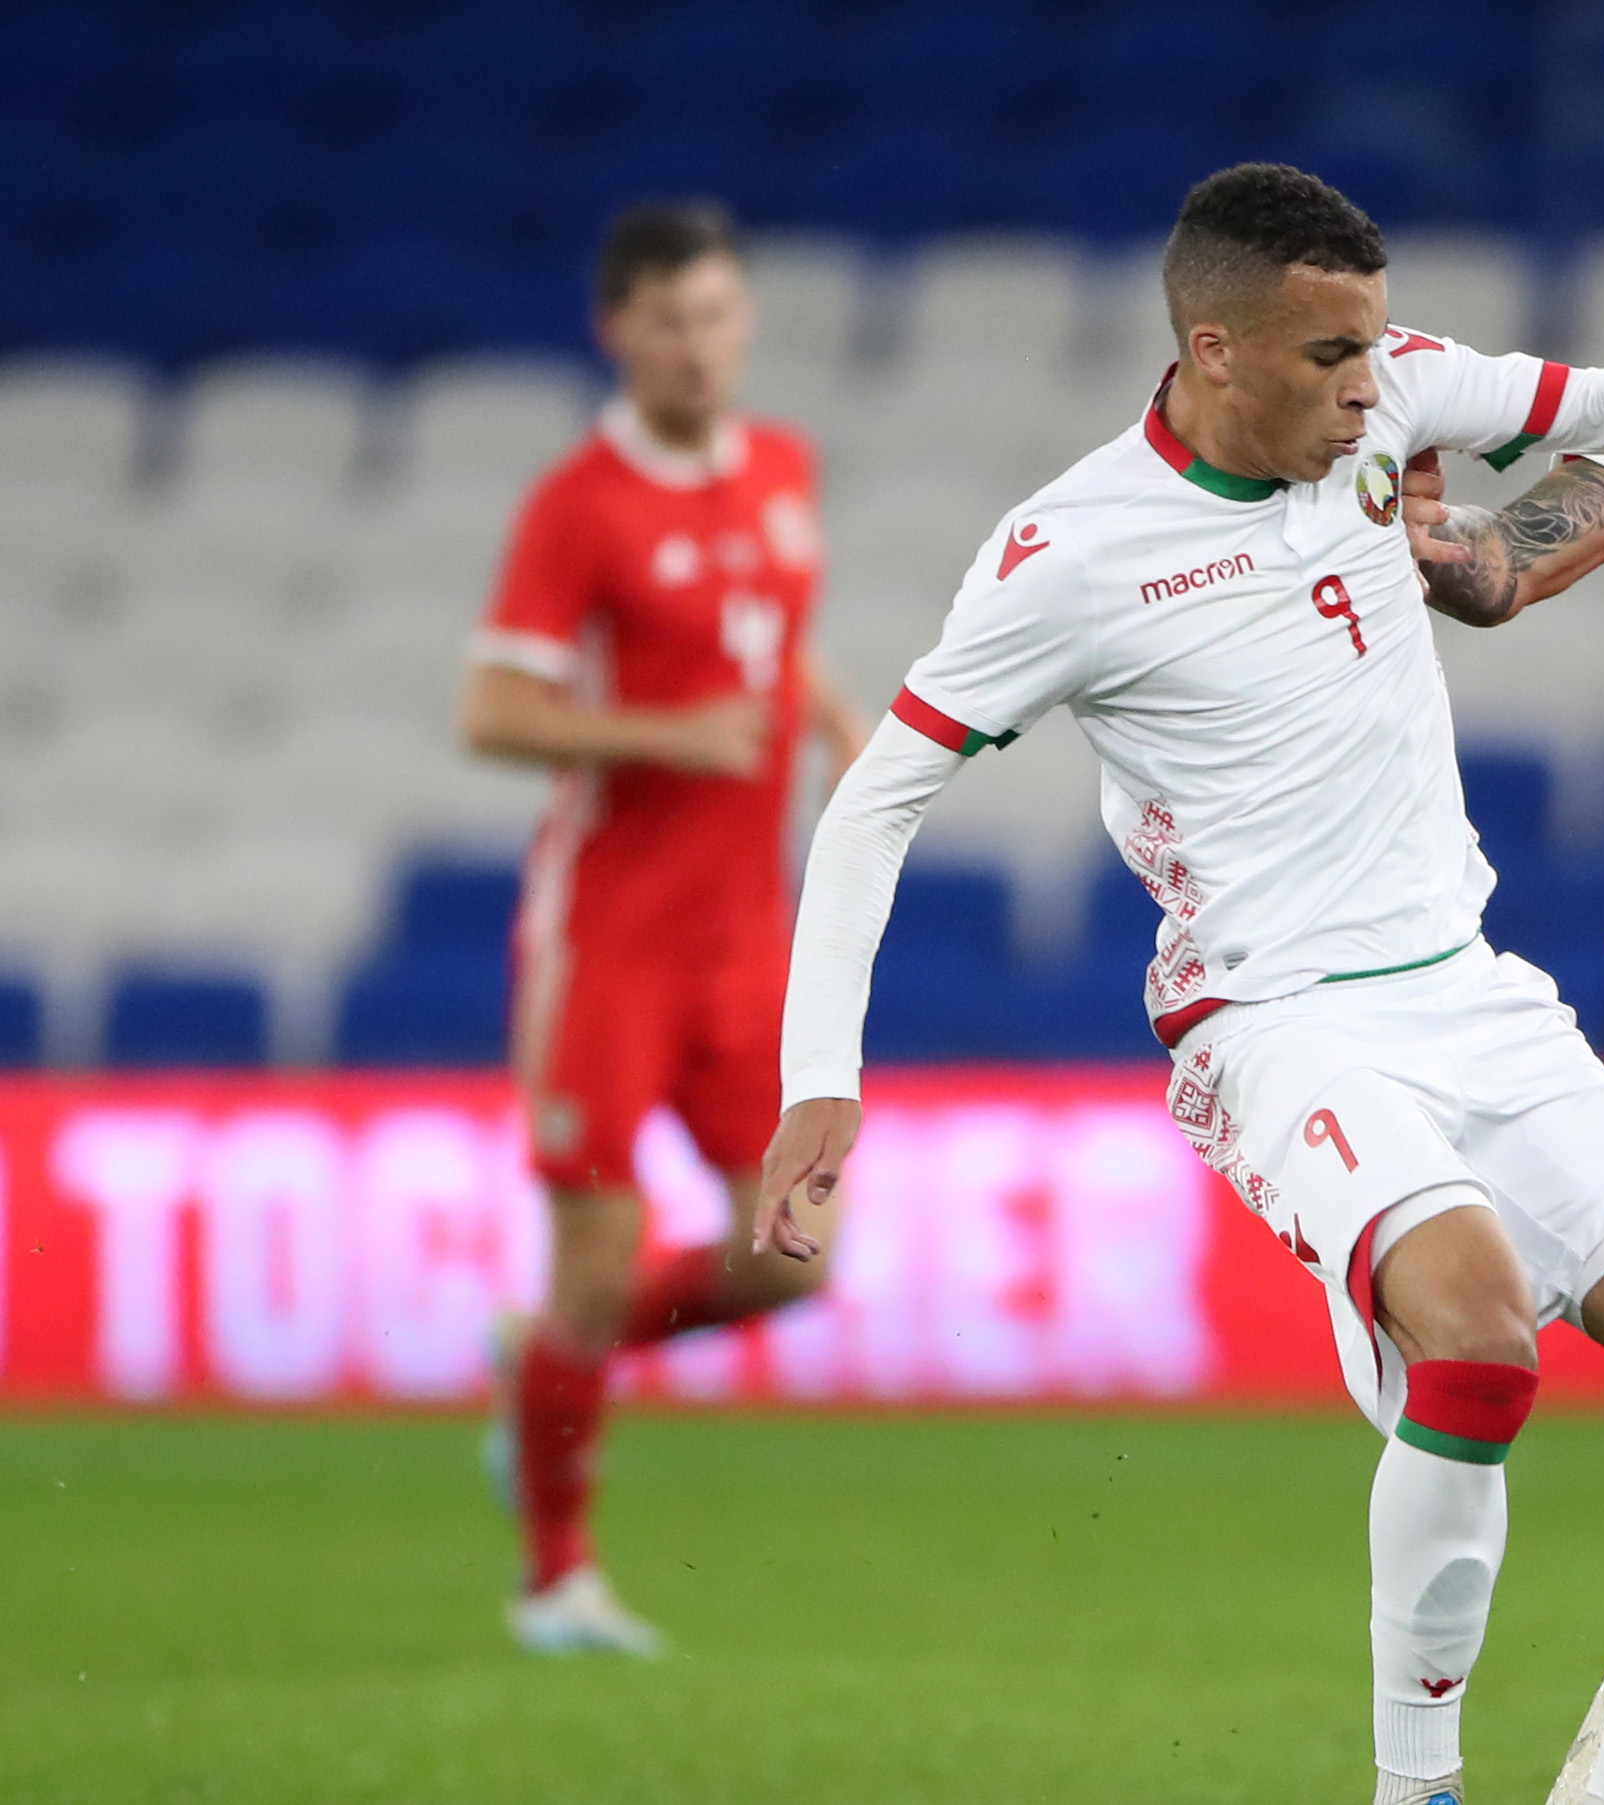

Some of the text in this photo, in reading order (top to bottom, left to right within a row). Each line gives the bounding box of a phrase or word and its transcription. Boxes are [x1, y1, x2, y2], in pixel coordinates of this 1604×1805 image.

[1140, 553, 1255, 605] macron
[1311, 574, 1367, 658] 9
[1303, 1108, 1360, 1173] 9
[50, 1104, 1212, 1403] TOGHER
